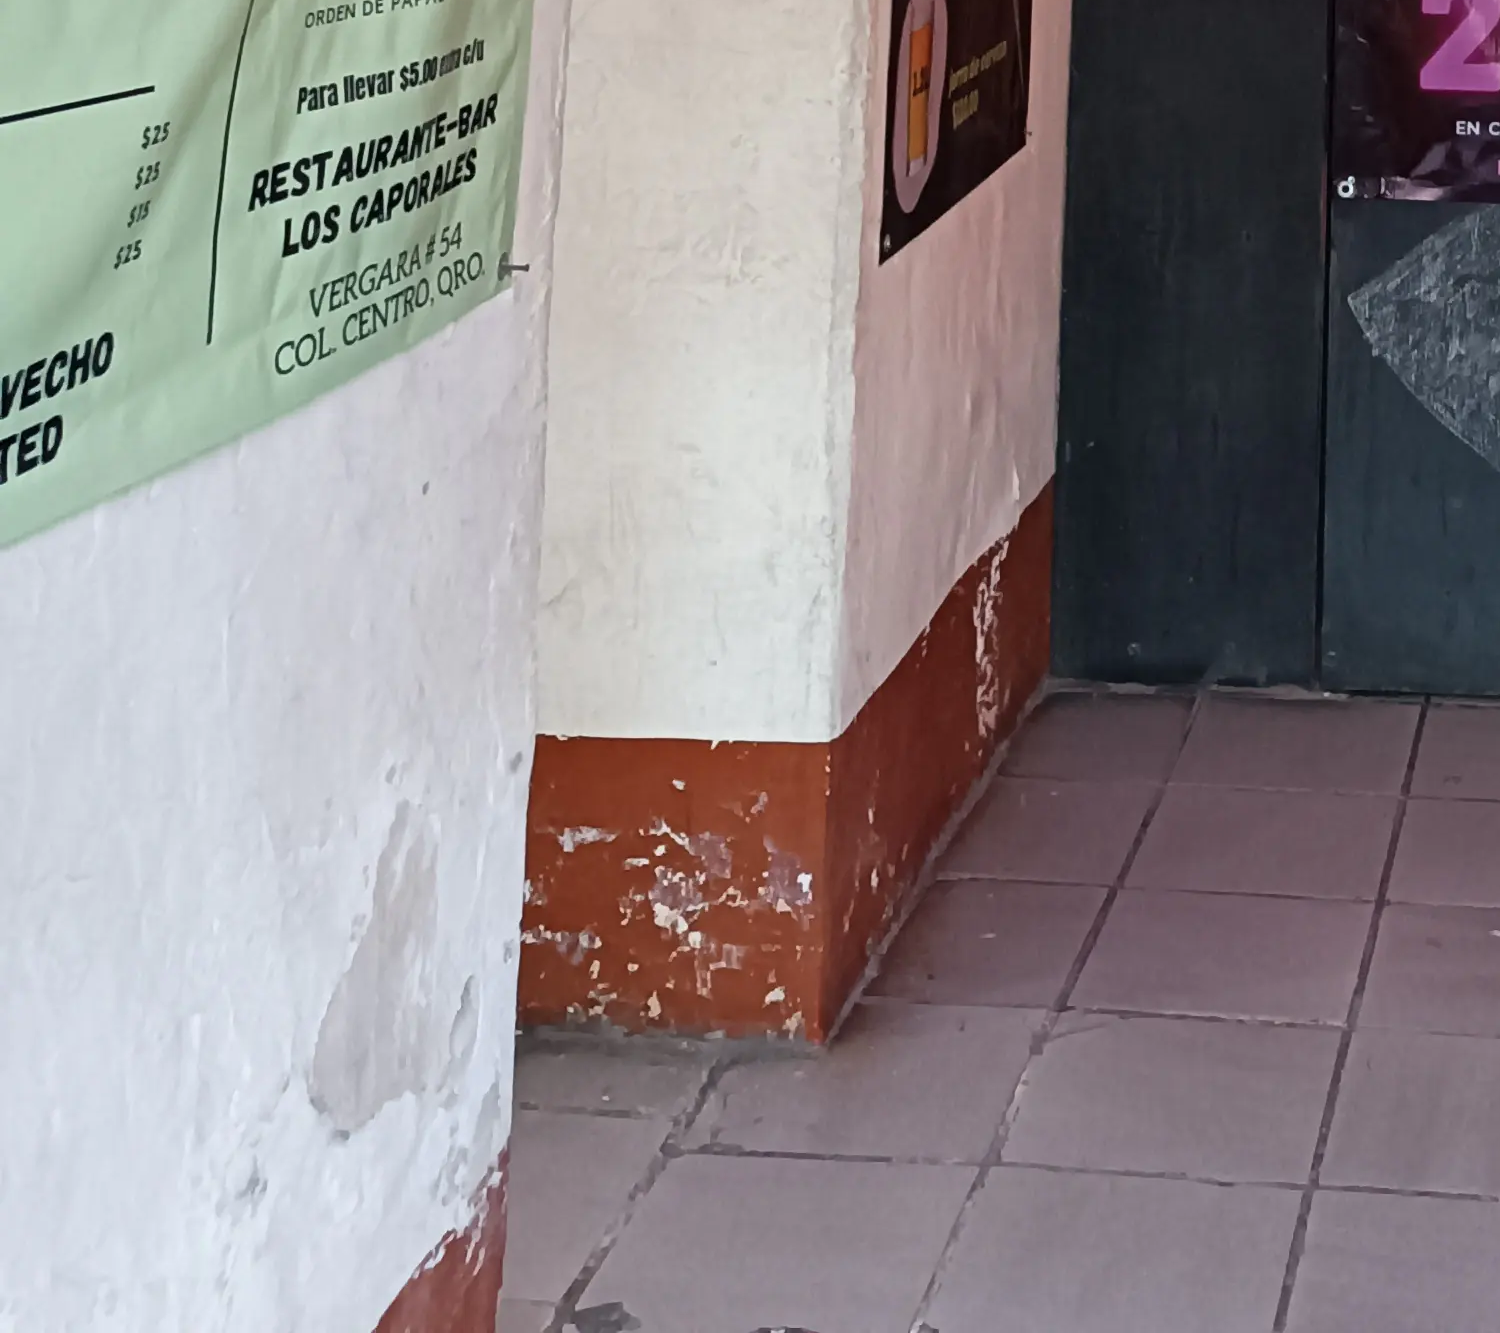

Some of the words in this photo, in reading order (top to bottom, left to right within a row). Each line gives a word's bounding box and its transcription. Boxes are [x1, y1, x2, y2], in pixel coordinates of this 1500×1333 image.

[303, 2, 356, 29] ORDEN
[296, 81, 339, 115] Para
[343, 68, 395, 104] llevar
[399, 58, 438, 92] $5.00
[141, 121, 170, 150] $25
[247, 92, 499, 213] RESTAURANTE-BAR
[1455, 121, 1480, 136] EN
[134, 161, 161, 190] $25
[281, 204, 341, 258] LOS
[349, 147, 478, 234] CAPORALES
[113, 239, 142, 270] $25
[308, 246, 422, 319] VERGARA
[425, 232, 437, 265] #
[439, 221, 463, 259] 54
[274, 326, 337, 376] COL.
[341, 277, 436, 347] CENTRO,
[436, 251, 486, 299] QRO.
[0, 332, 114, 420] VECHO
